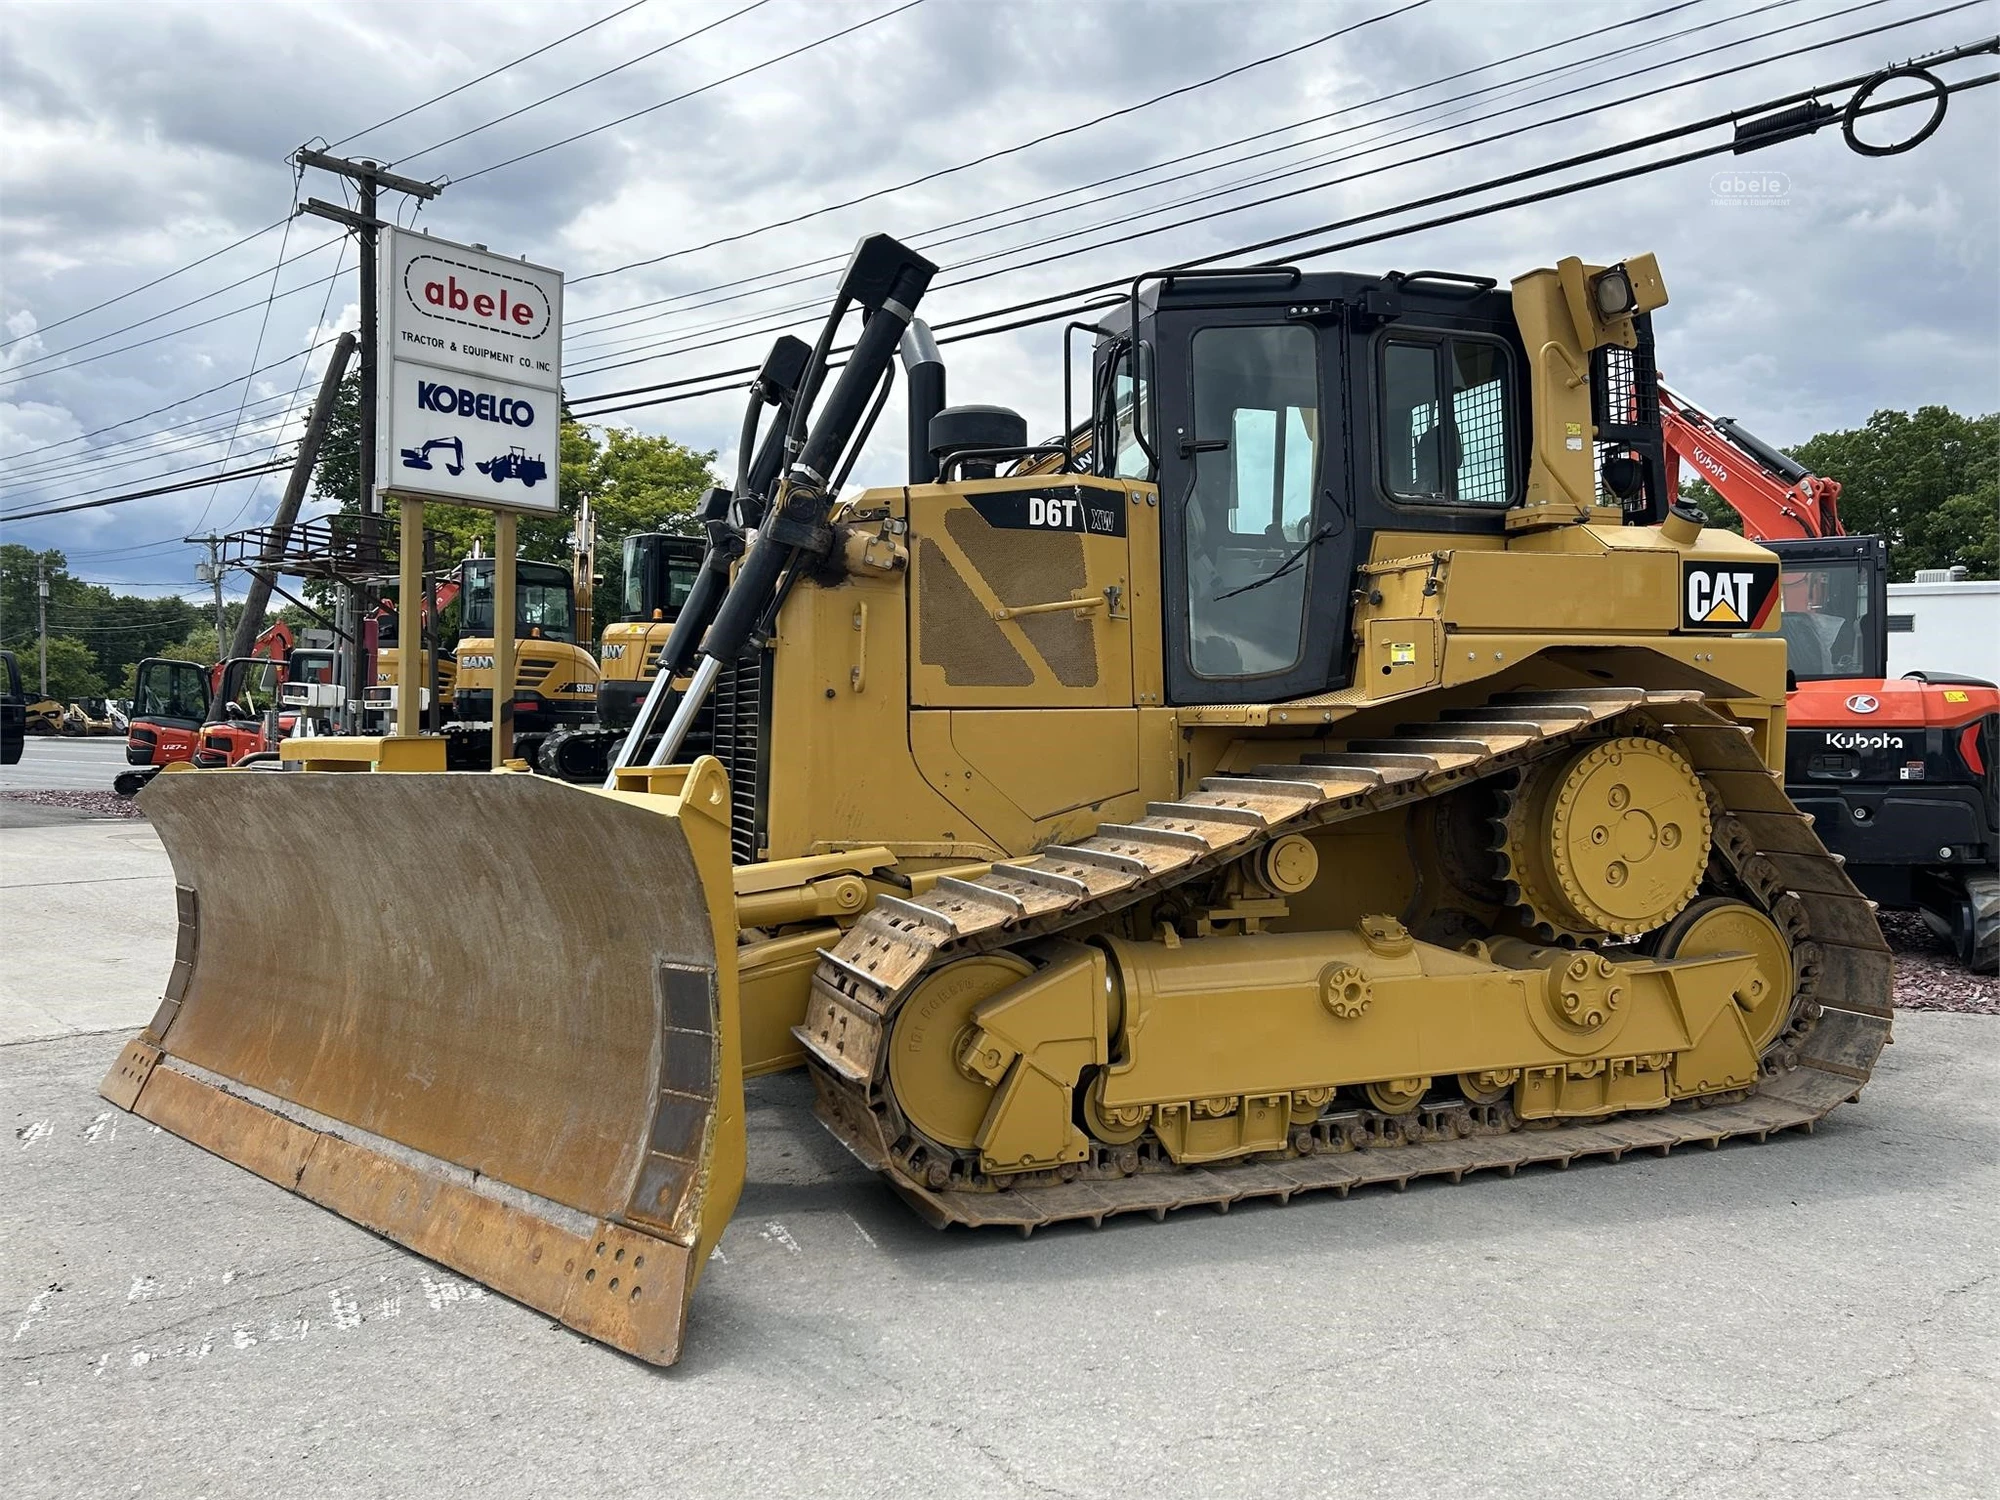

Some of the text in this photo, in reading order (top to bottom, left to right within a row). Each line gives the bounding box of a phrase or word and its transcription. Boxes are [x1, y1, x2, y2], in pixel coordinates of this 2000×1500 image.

[424, 276, 535, 326] abele
[401, 331, 445, 349] TRACTOR
[449, 341, 457, 352] &
[463, 344, 514, 364] EQUIPMENT
[418, 380, 535, 428] KOBELCO
[1693, 446, 1727, 482] Kubota
[1029, 497, 1115, 532] D6T XW
[1688, 570, 1754, 623] CAT
[377, 673, 391, 682] NY
[1826, 733, 1903, 749] Kubota
